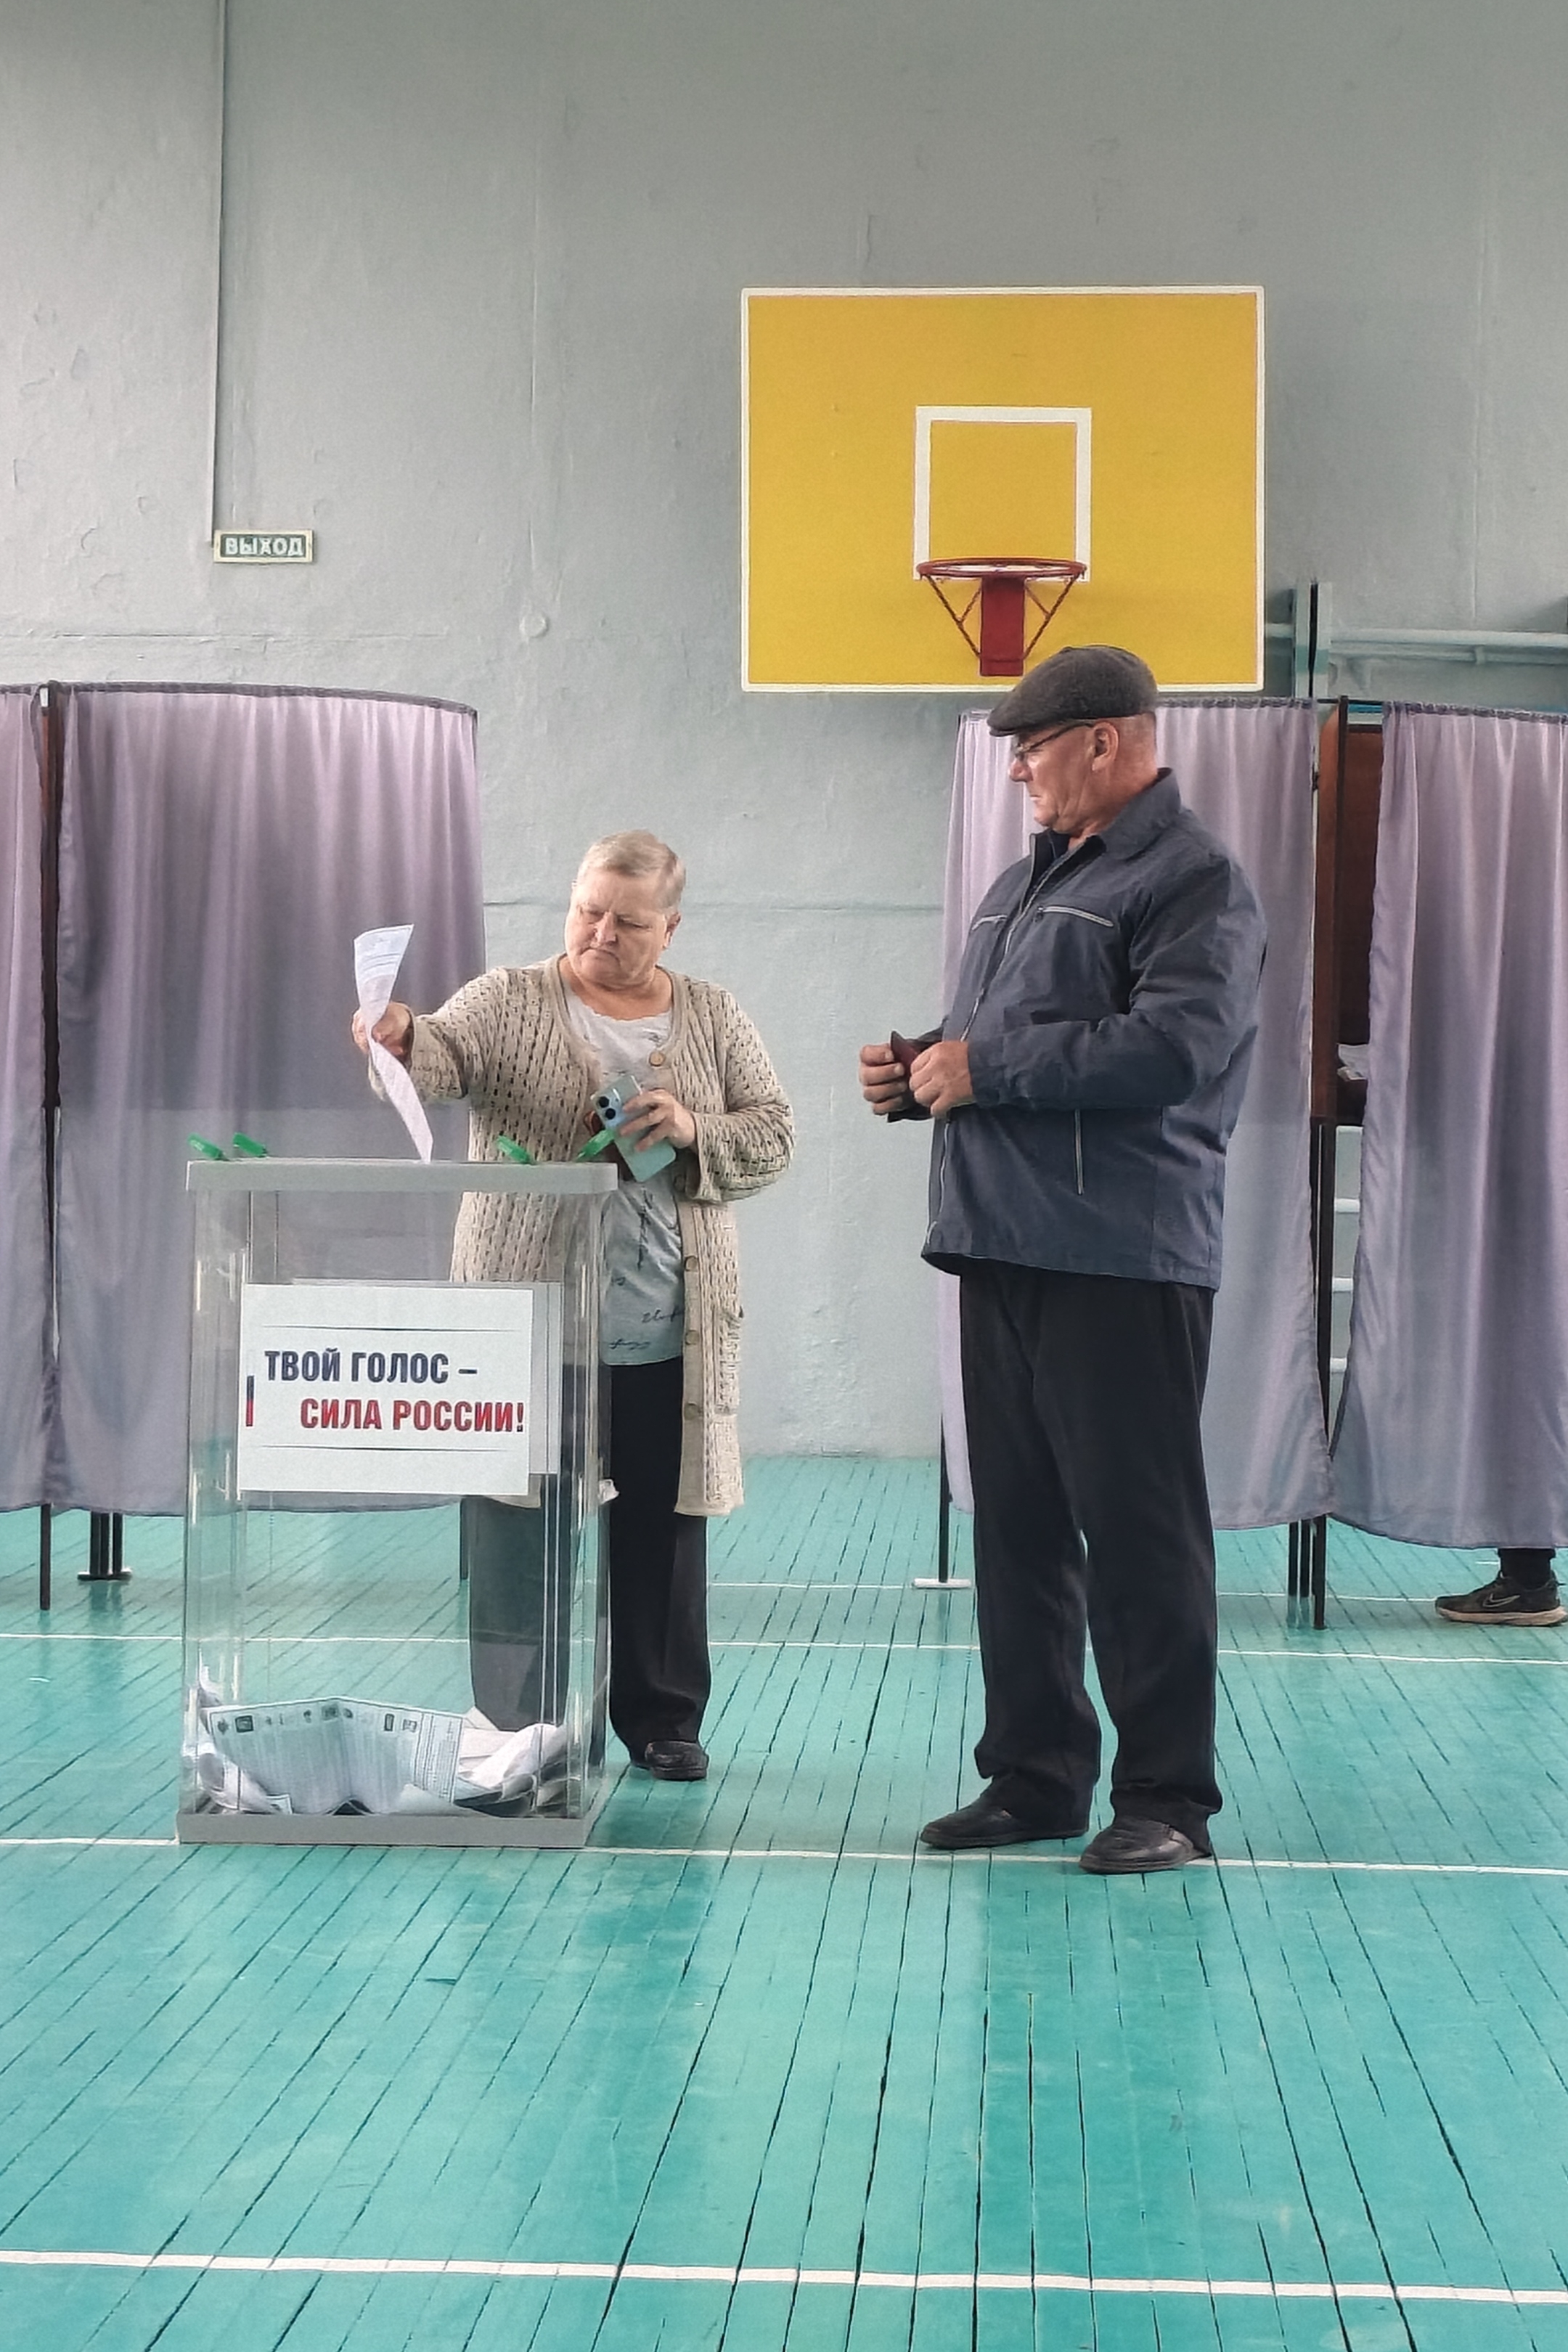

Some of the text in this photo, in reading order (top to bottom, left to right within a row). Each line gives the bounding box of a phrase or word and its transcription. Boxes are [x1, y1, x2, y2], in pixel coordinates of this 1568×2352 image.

[225, 537, 303, 556] ВЫХОД
[264, 1348, 340, 1382] ТВОЙ
[351, 1352, 449, 1384] ГОЛОС
[301, 1398, 524, 1432] СИЛА РОССИИ!
